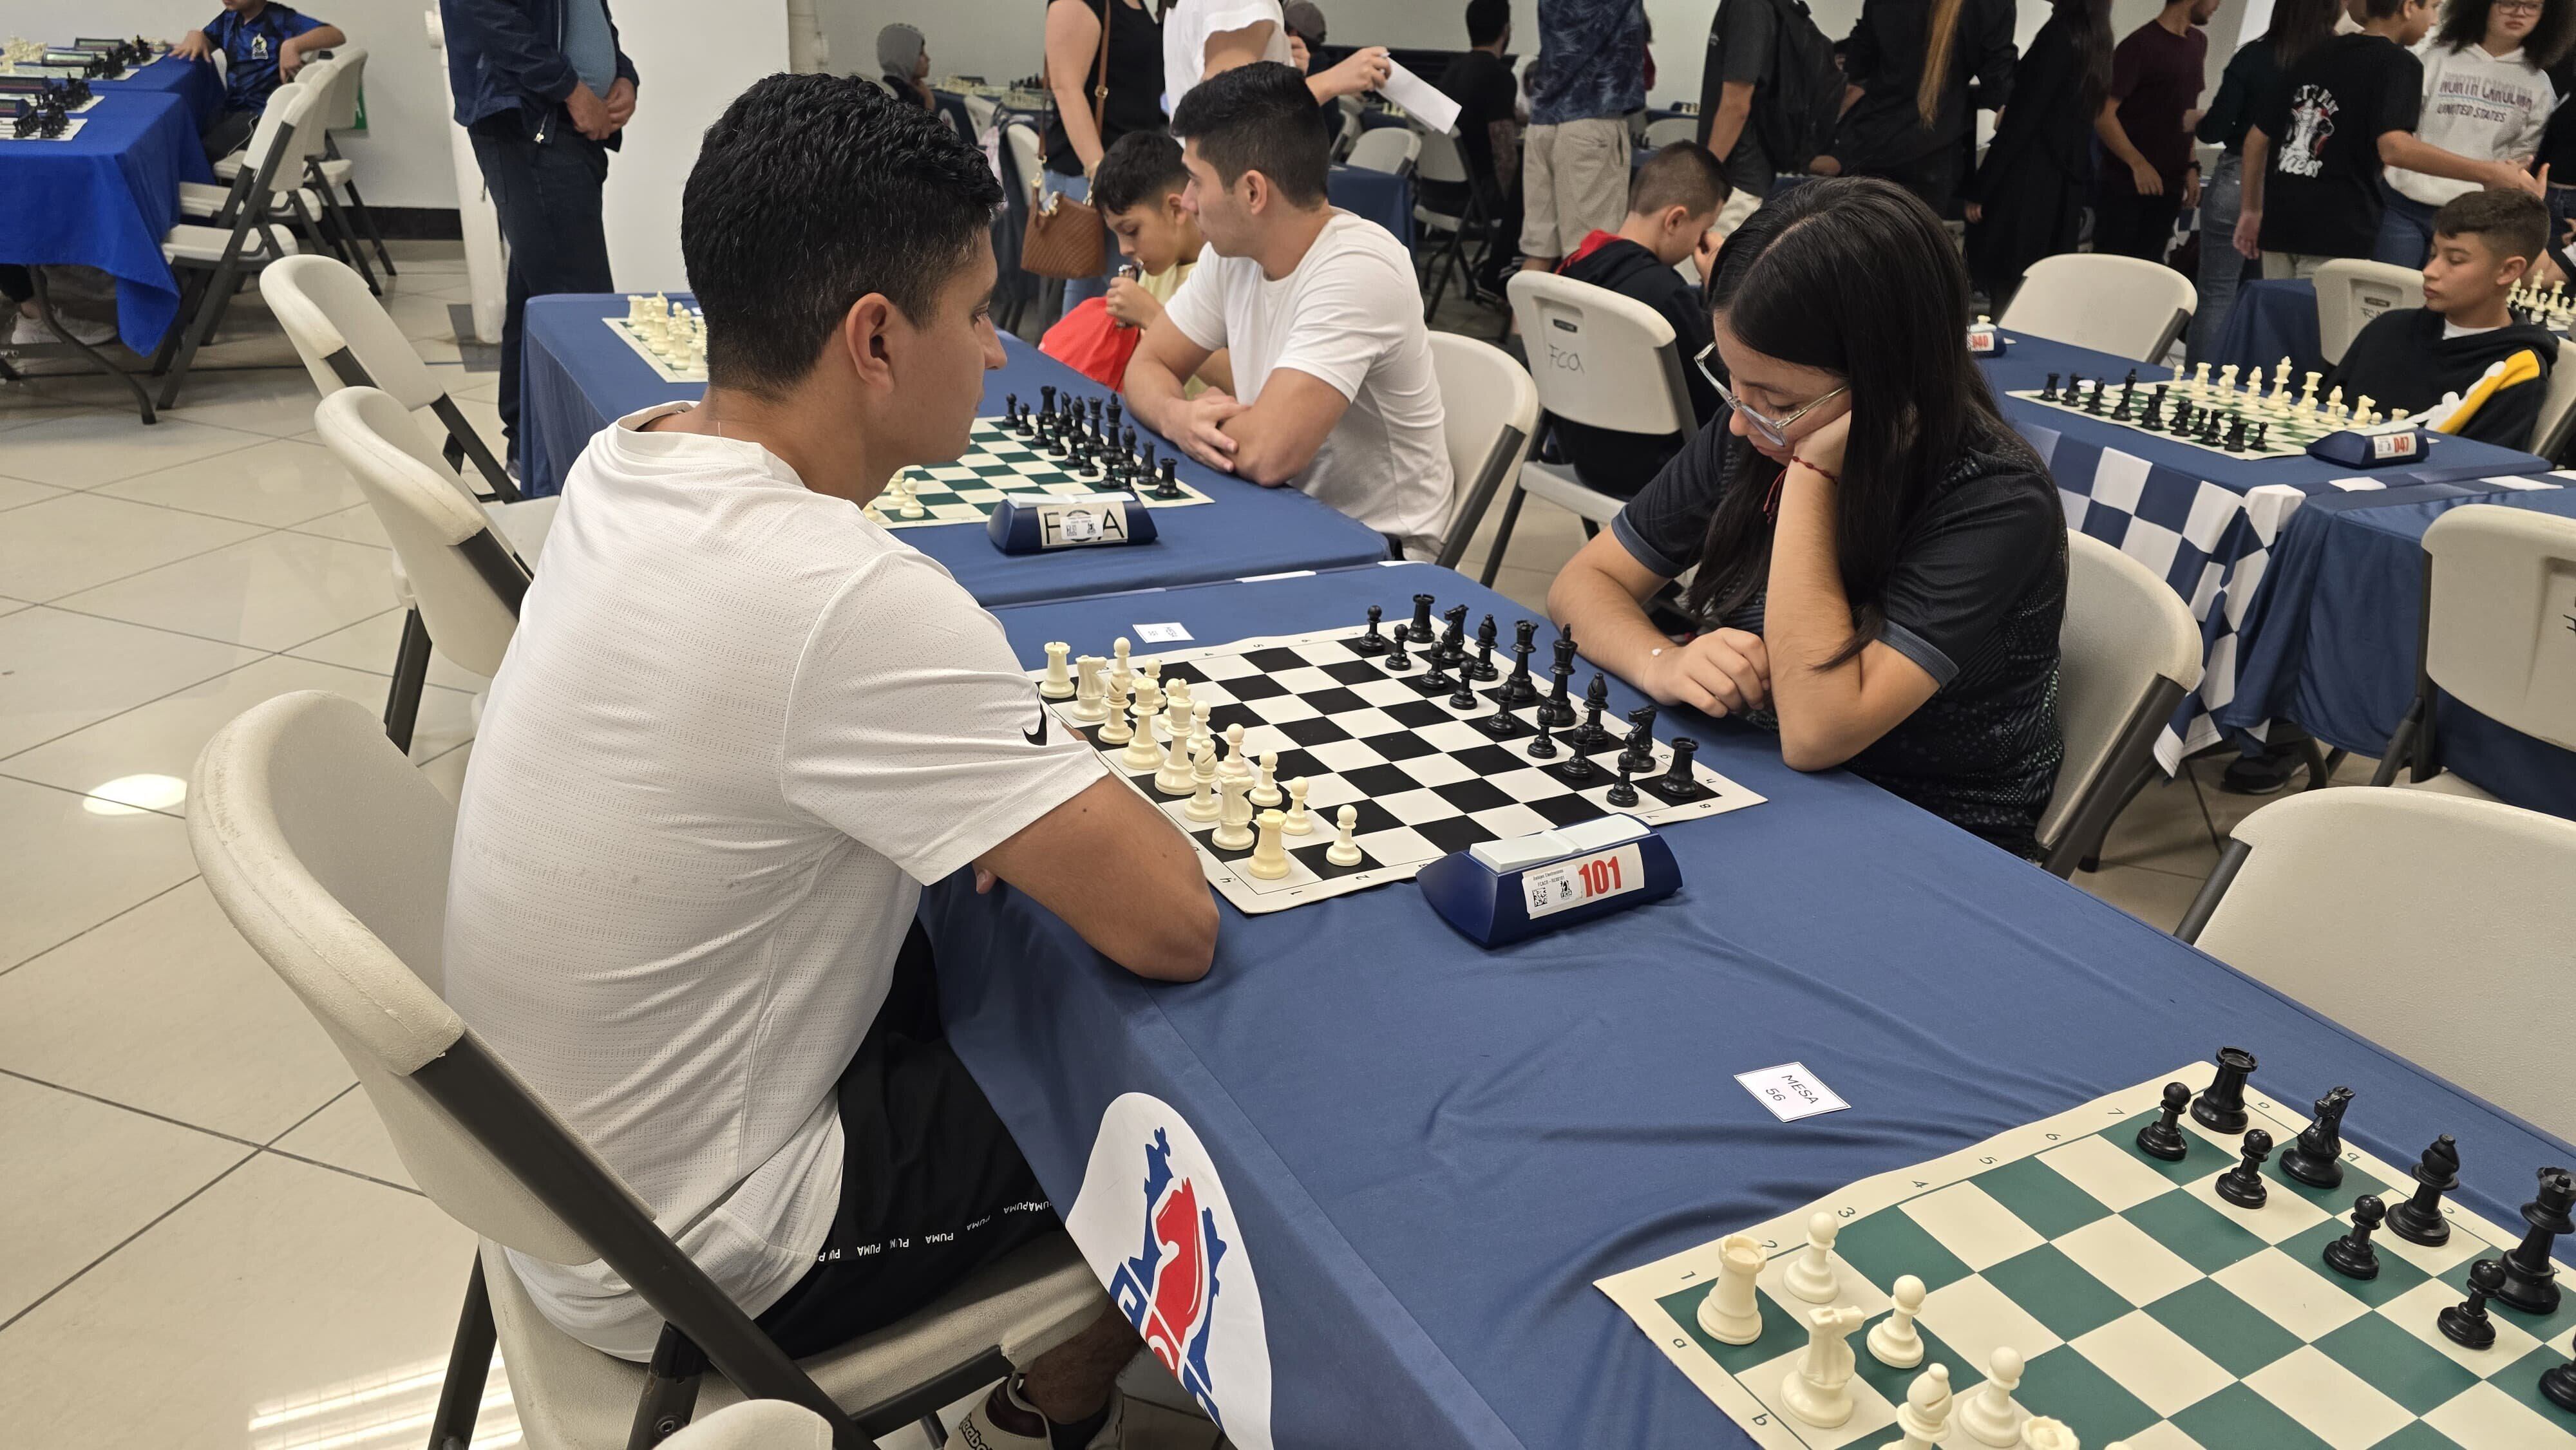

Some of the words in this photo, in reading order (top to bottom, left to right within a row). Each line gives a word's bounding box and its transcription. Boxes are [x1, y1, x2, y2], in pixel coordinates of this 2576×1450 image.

[2437, 103, 2474, 116] UNITED
[2473, 107, 2507, 123] STATES
[1578, 855, 1622, 898] 101
[1765, 1088, 1786, 1102] 56
[1781, 1075, 1819, 1104] MESA
[2107, 1107, 2126, 1116] 7
[2045, 1132, 2061, 1142] 6
[1978, 1156, 1998, 1165] 5
[2347, 1152, 2360, 1162] b
[1911, 1179, 1930, 1189] 4
[1003, 1201, 1028, 1214] PUMA
[1837, 1206, 1857, 1219] 3
[966, 1214, 991, 1231] PUMA
[925, 1232, 954, 1244] PUMA
[1761, 1239, 1778, 1248] 2
[857, 1243, 881, 1256] PUMA
[1680, 1270, 1696, 1280] 1
[1672, 1338, 1687, 1348] a
[1751, 1413, 1768, 1426] b
